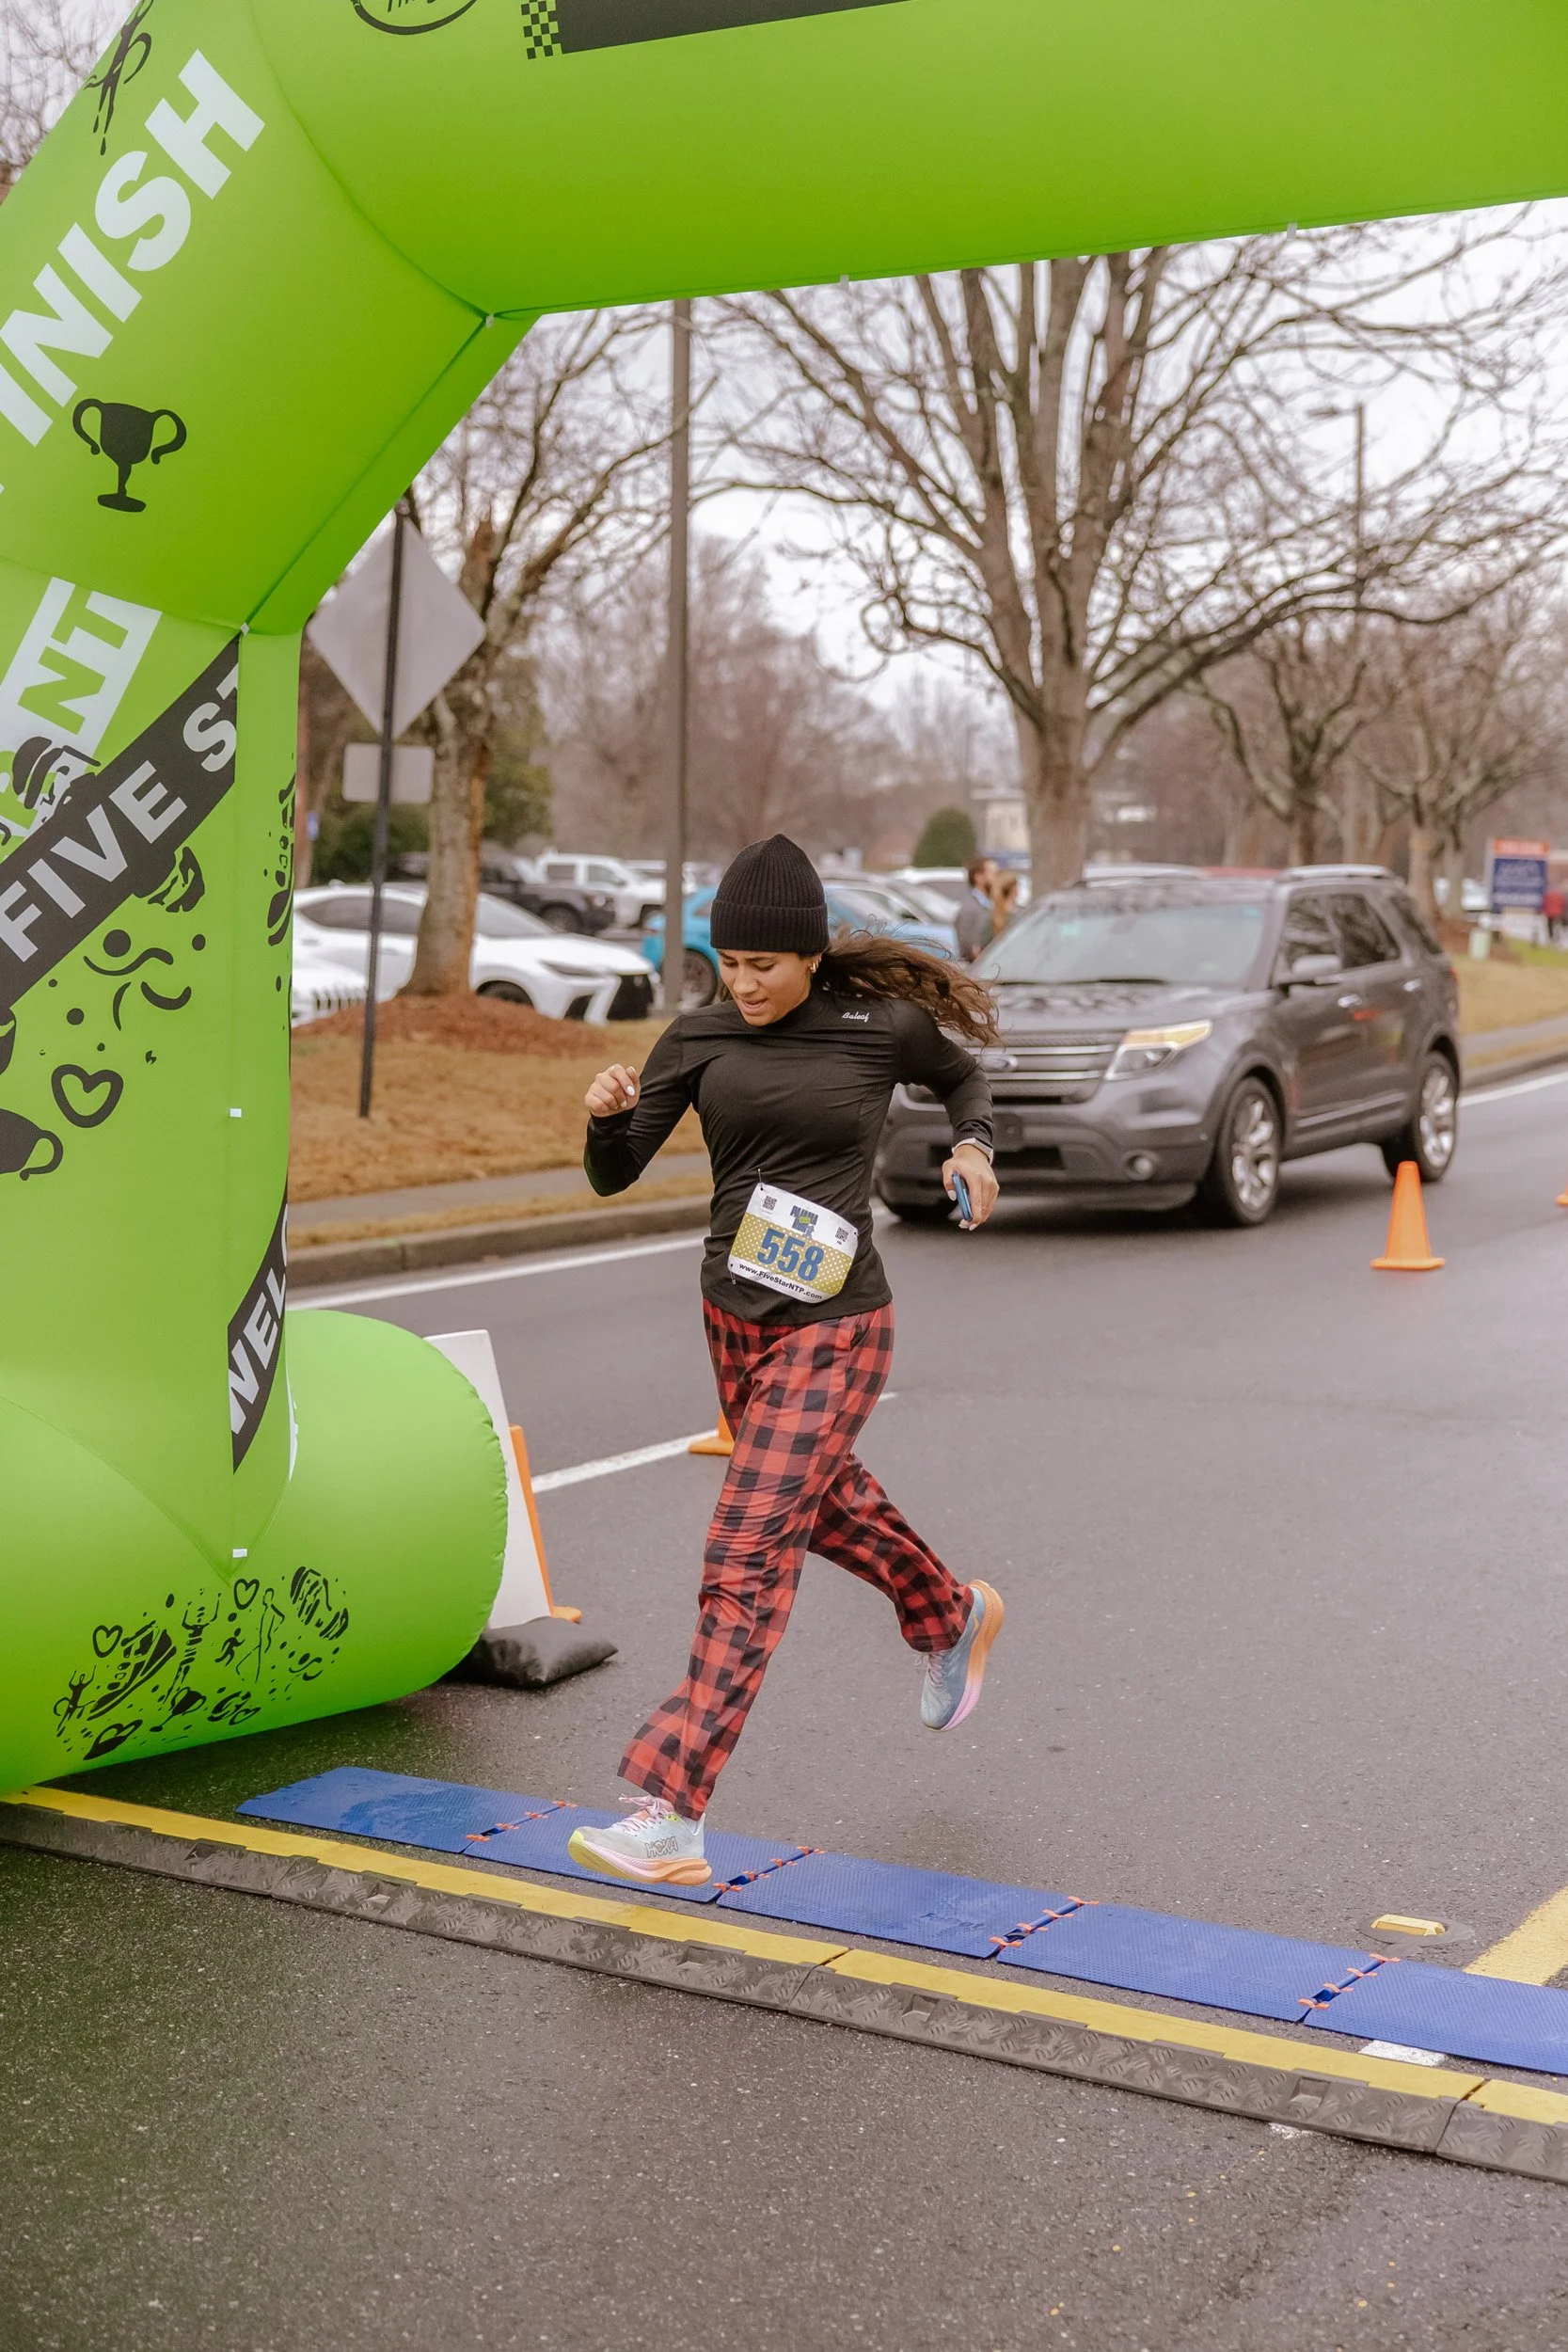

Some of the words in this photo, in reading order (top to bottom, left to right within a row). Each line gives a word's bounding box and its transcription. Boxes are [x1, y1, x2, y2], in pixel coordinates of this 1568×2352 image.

[0, 48, 265, 494] INISH
[0, 760, 187, 962] FIVE
[841, 1011, 870, 1023] Baleaf
[757, 1228, 824, 1281] 558
[739, 1263, 823, 1300] www.FiveStarNTP.com
[644, 1836, 678, 1858] HOKA
